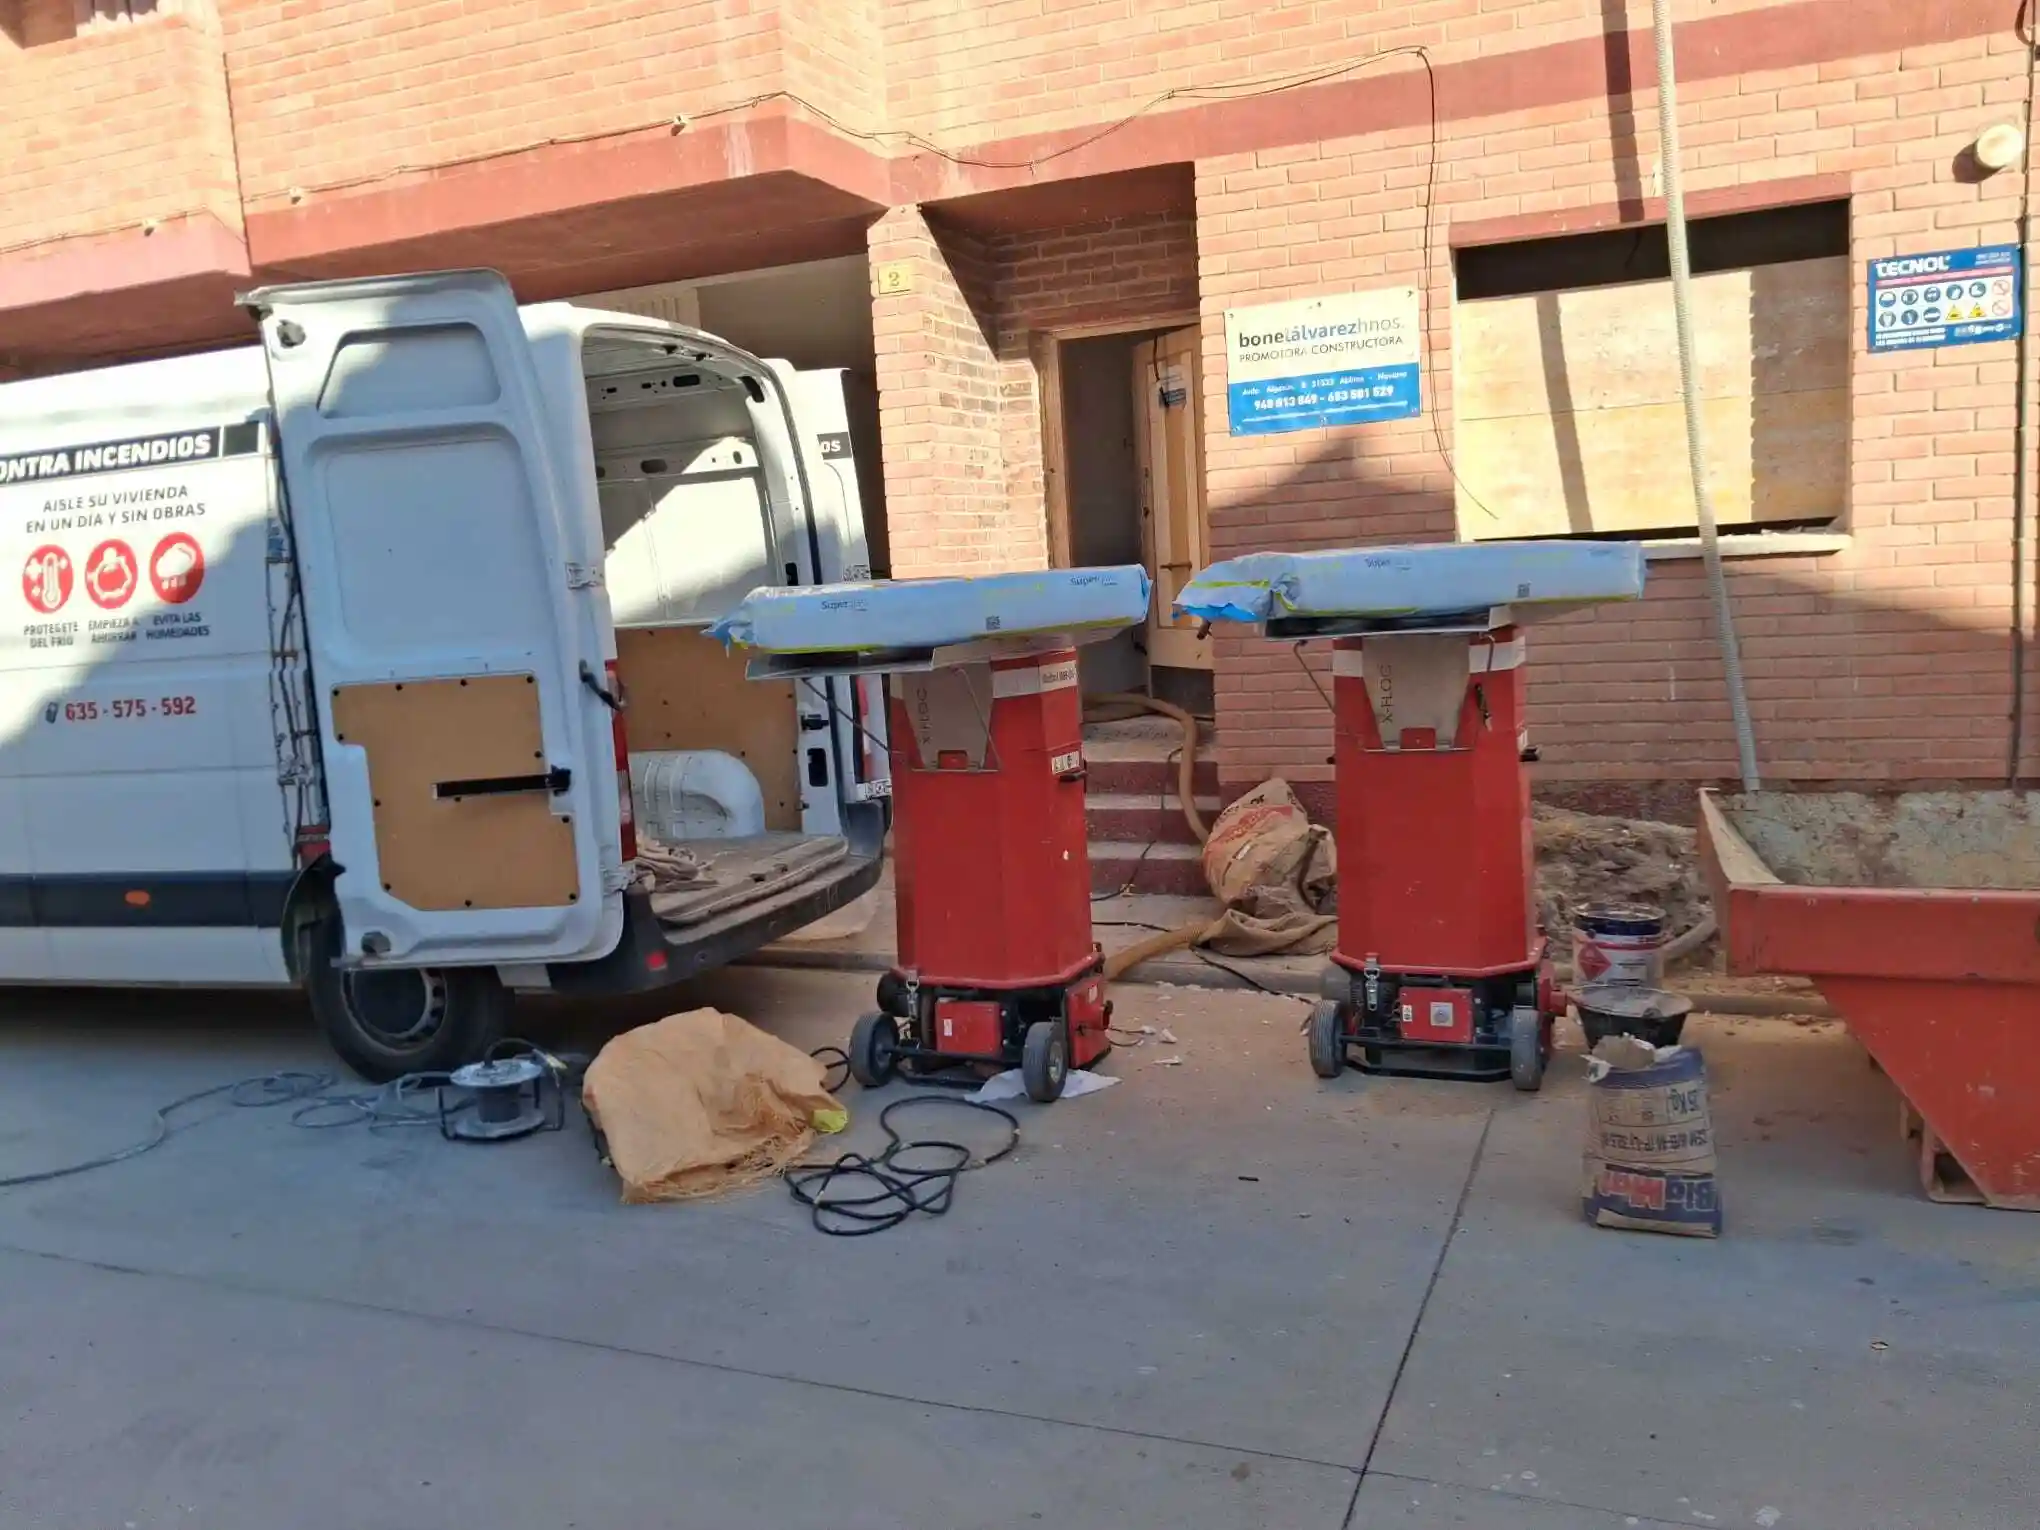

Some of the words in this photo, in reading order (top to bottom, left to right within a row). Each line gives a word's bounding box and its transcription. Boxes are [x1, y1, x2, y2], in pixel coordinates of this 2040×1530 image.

[1876, 256, 1949, 277] TECNOL
[889, 271, 900, 286] 2
[1239, 347, 1308, 362] PROMOTORA
[1312, 335, 1404, 355] CONSTRUCTORA
[75, 433, 211, 471] INCENDIOS
[43, 496, 83, 513] AISLE
[88, 494, 107, 508] SU
[112, 485, 188, 505] VIVIENDA
[26, 520, 45, 534] EN
[50, 517, 72, 531] UN
[108, 512, 116, 525] Y
[121, 509, 148, 524] SIN
[153, 503, 206, 520] OBRAS
[153, 613, 181, 626] EVITA
[183, 611, 202, 623] LAS
[29, 637, 48, 648] DEL
[146, 625, 211, 641] HUMEDADES
[65, 701, 97, 721] 635
[112, 698, 147, 718] 575
[161, 696, 196, 716] 592
